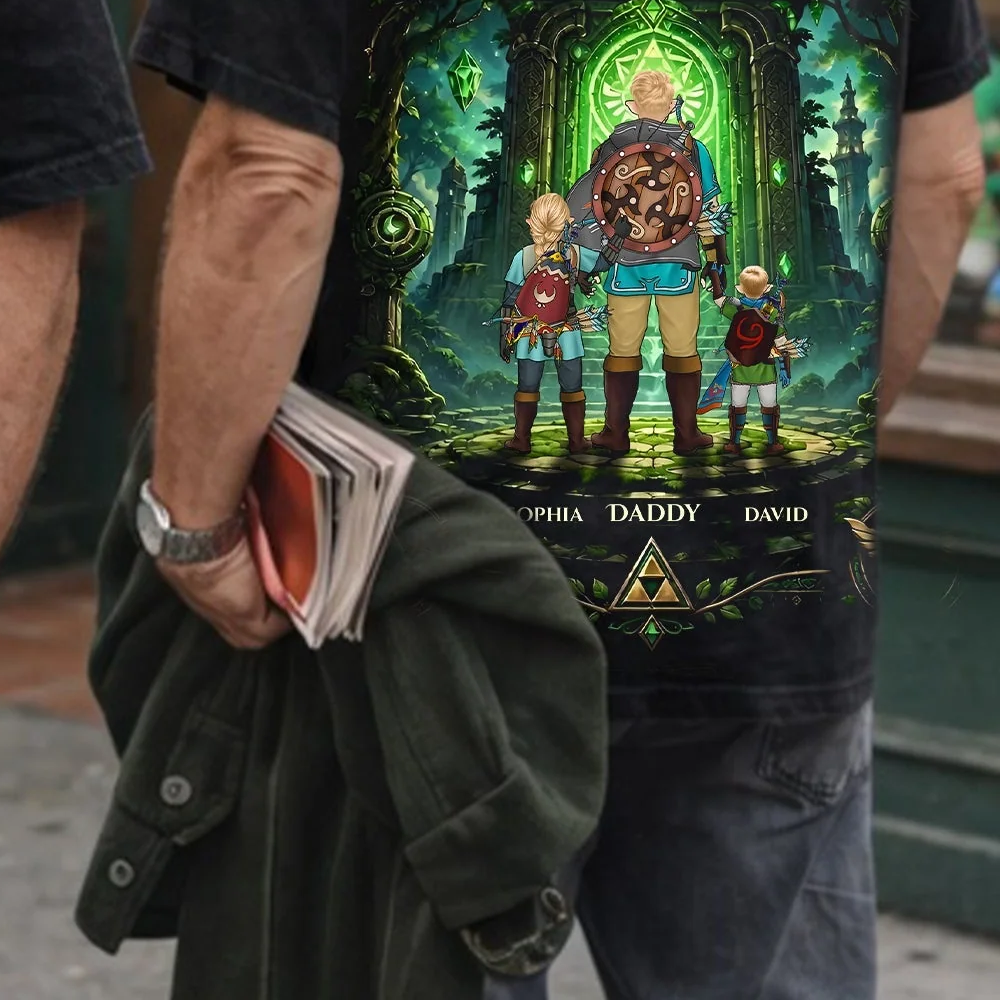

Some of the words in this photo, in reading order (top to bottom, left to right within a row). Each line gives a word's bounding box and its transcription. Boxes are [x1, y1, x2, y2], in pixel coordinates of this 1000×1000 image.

[516, 506, 583, 522] OPHIA
[605, 503, 701, 522] DADDY
[744, 506, 808, 522] DAVID
